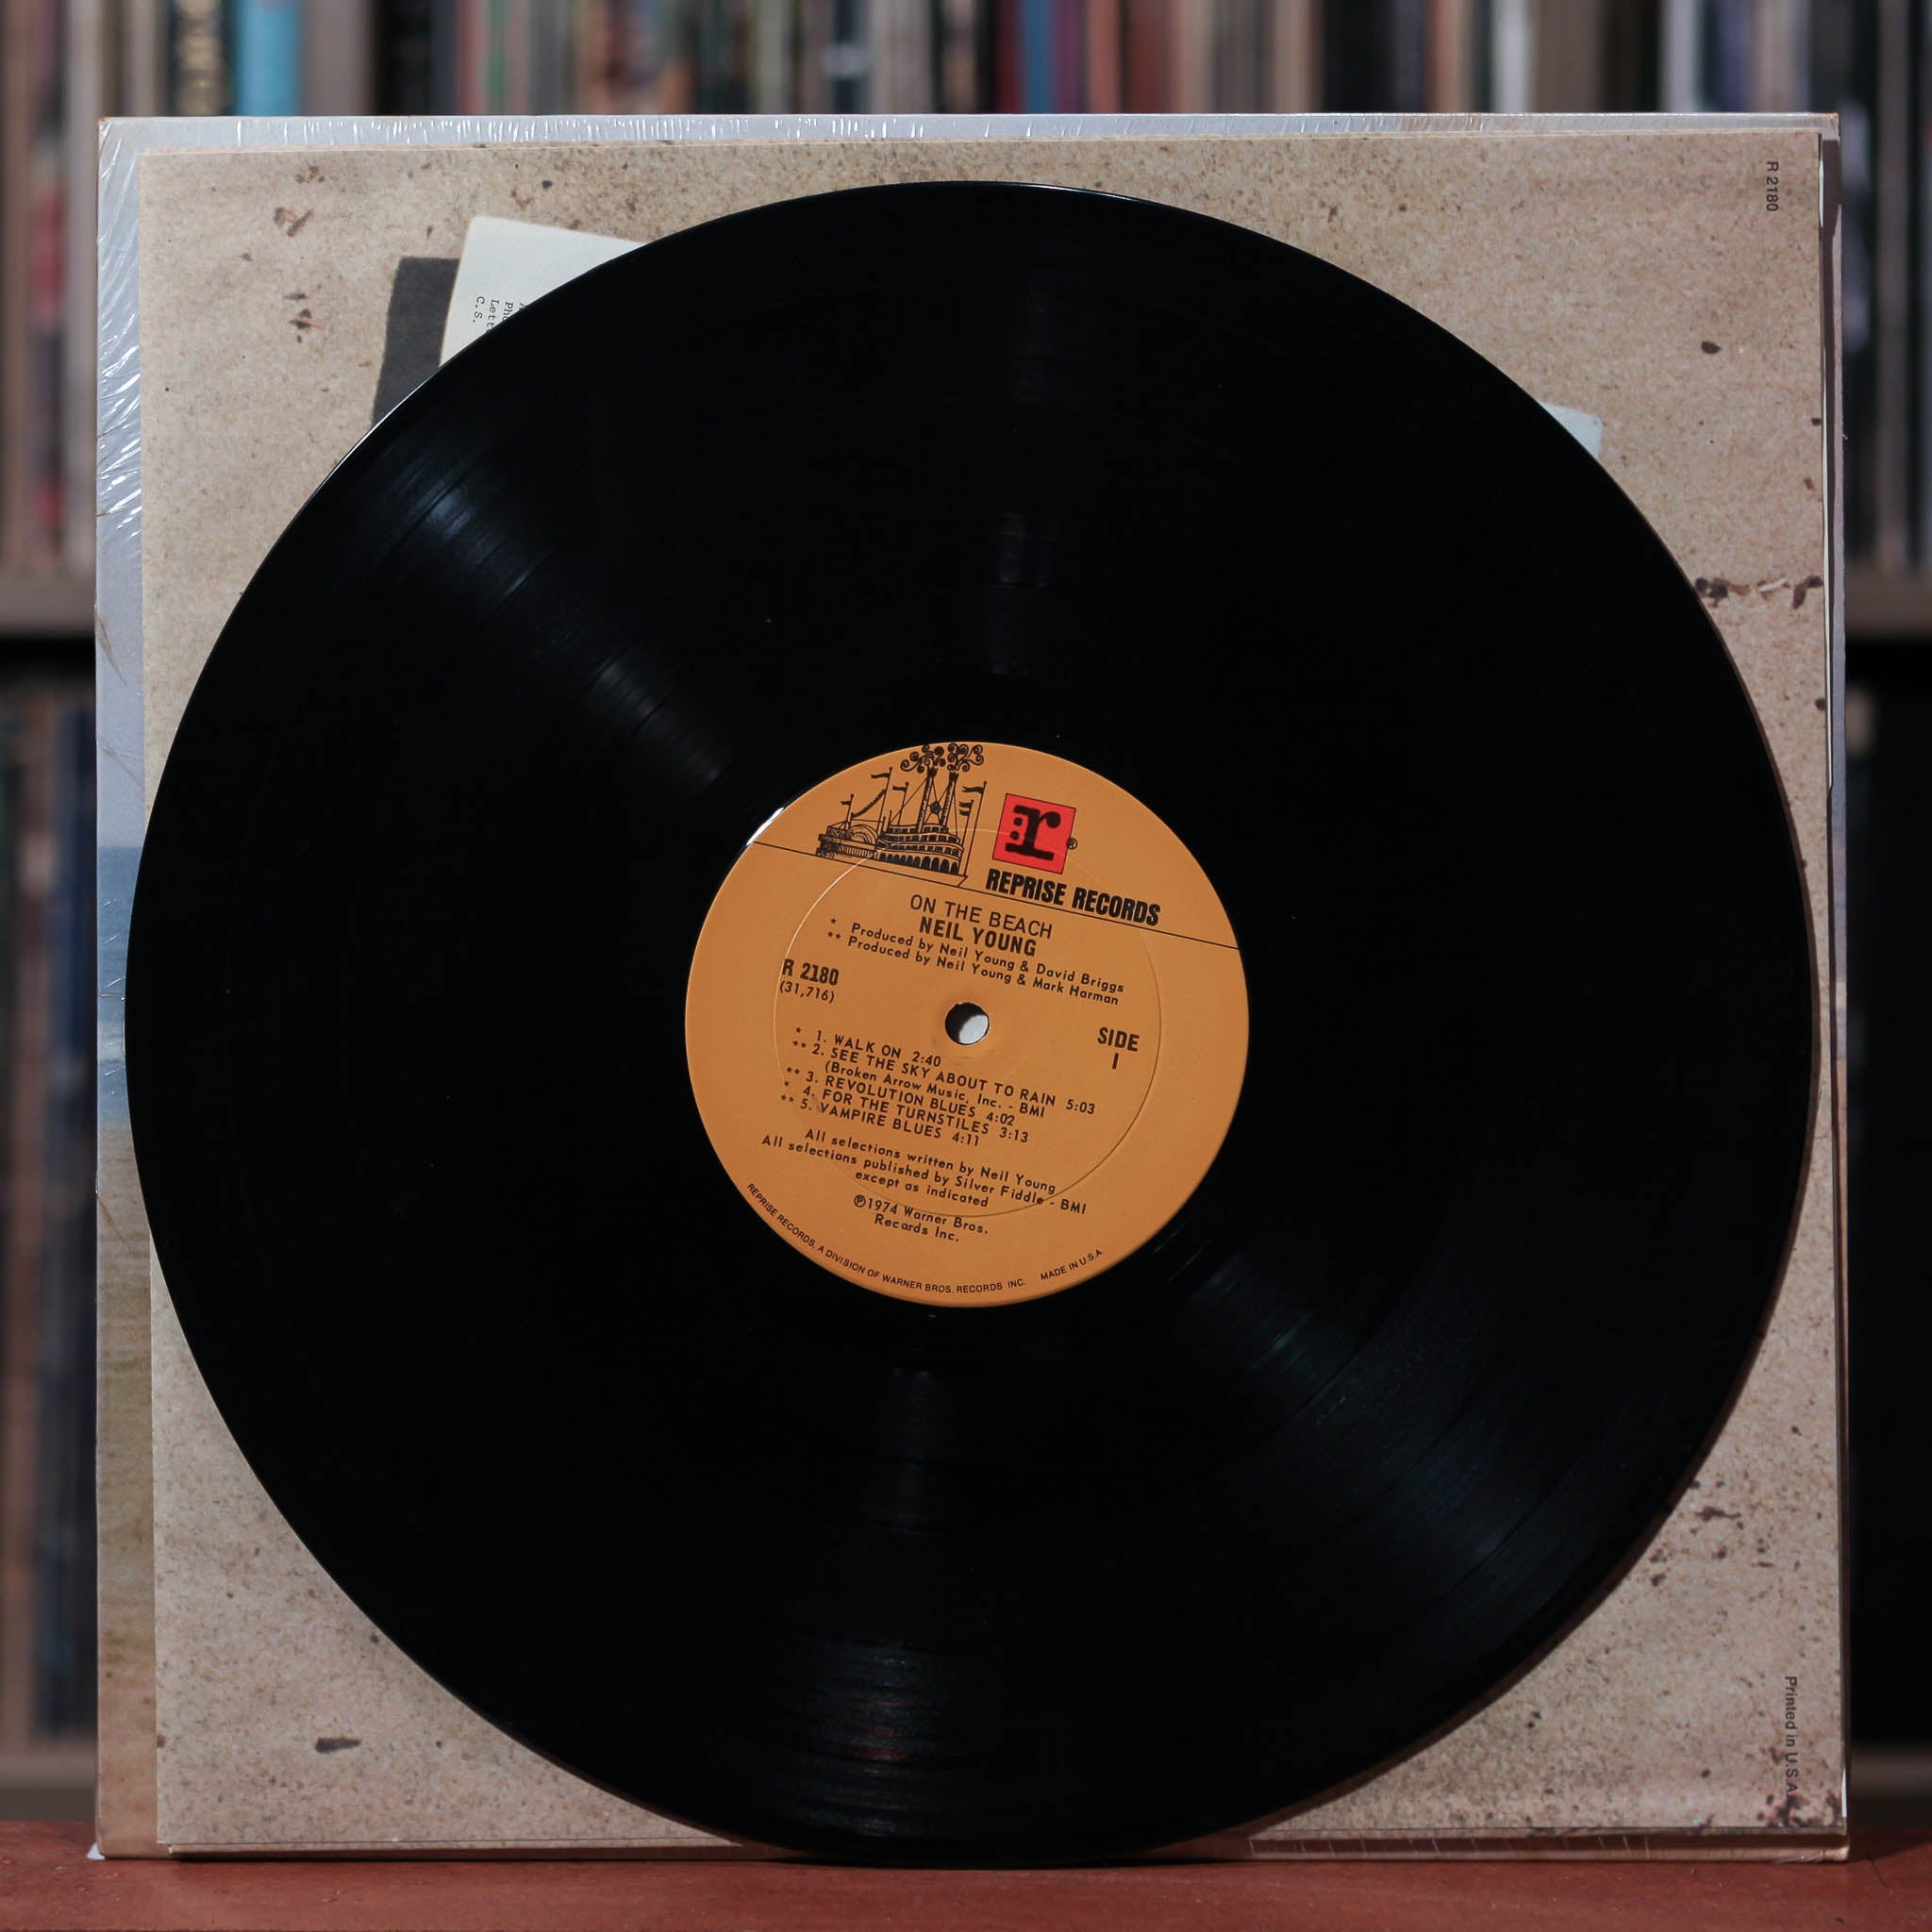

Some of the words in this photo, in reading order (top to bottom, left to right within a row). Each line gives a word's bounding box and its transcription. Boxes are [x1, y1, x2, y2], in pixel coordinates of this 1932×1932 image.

[1766, 161, 1779, 172] R
[1765, 176, 1779, 212] 2180
[910, 894, 936, 913] ON
[945, 901, 982, 923] THE
[989, 912, 1053, 939] BEACH
[986, 868, 1067, 906] REPRISE
[1072, 887, 1160, 925] RECORDS
[851, 922, 913, 946] Produced
[919, 938, 933, 952] by
[940, 943, 968, 958] Neil
[974, 950, 1015, 972] Young
[1020, 960, 1029, 973] &
[1037, 963, 1075, 982] David
[1081, 974, 1124, 994] Briggs
[919, 916, 964, 941] NEIL
[973, 927, 1037, 957] YOUNG
[779, 981, 835, 1004] (31,716)
[782, 958, 794, 976] R
[800, 962, 840, 986] 2180
[848, 936, 909, 959] Produced
[916, 952, 930, 966] by
[936, 957, 964, 972] Neil
[972, 964, 1011, 984] Young
[1017, 974, 1026, 986] &
[1033, 977, 1064, 993] Mark
[1070, 986, 1119, 1006] Harman
[817, 1030, 826, 1042] 1.
[835, 1034, 875, 1053] WALK
[881, 1045, 901, 1058] ON
[911, 1052, 941, 1067] 2:40
[1097, 1027, 1140, 1052] SIDE
[806, 1072, 818, 1083] 3.
[825, 1075, 924, 1106] REVOLUTION
[930, 1098, 975, 1117] BLUES
[986, 1112, 1015, 1125] 4:02
[812, 1044, 824, 1056] 2.
[830, 1048, 858, 1063] SEE
[867, 1056, 895, 1071] THE
[902, 1063, 930, 1078] SKY
[936, 1074, 988, 1091] ABOUT
[994, 1082, 1014, 1096] TO
[1020, 1089, 1056, 1107] RAIN
[1066, 1099, 1095, 1115] 5:03
[824, 1060, 877, 1082] (Broken
[883, 1074, 922, 1091] Arrow
[977, 1093, 1002, 1108] Inc.
[1019, 1103, 1045, 1118] BMI
[800, 1099, 811, 1110] 5.
[820, 1103, 886, 1126] VAMPIRE
[892, 1119, 941, 1139] BLUES
[952, 1132, 979, 1146] 4:11
[803, 1086, 815, 1096] 4.
[823, 1089, 853, 1105] FOR
[860, 1097, 890, 1113] THE
[897, 1105, 989, 1134] TURNSTILES
[999, 1127, 1028, 1143] 3:13
[762, 1135, 782, 1148] All
[789, 1141, 857, 1164] selections
[863, 1158, 929, 1180] published
[934, 1172, 949, 1186] by
[955, 1175, 994, 1194] Silver
[1000, 1185, 1044, 1205] Fiddle
[1060, 1199, 1087, 1214] BMI
[805, 1128, 825, 1142] All
[831, 1136, 900, 1159] selections
[908, 1153, 953, 1171] written
[959, 1162, 974, 1176] by
[980, 1166, 1008, 1182] Neil
[1016, 1174, 1056, 1194] Young
[856, 1171, 900, 1189] except
[905, 1182, 919, 1192] as
[926, 1185, 989, 1208] indicated
[747, 1183, 778, 1217] REPRISE
[818, 1245, 824, 1254] A
[825, 1249, 866, 1274] DIVISION
[867, 1269, 880, 1279] OF
[882, 1274, 923, 1291] WARNER
[957, 1282, 1003, 1293] RECORDS
[1008, 1278, 1026, 1289] INC.
[874, 1213, 928, 1236] Records
[935, 1227, 959, 1242] Inc.
[904, 1206, 948, 1225] Warner
[954, 1217, 989, 1234] Bros.
[1041, 1266, 1067, 1281] MADE
[1069, 1260, 1079, 1271] IN
[1785, 1675, 1798, 1729] Printed
[1785, 1735, 1798, 1747] in
